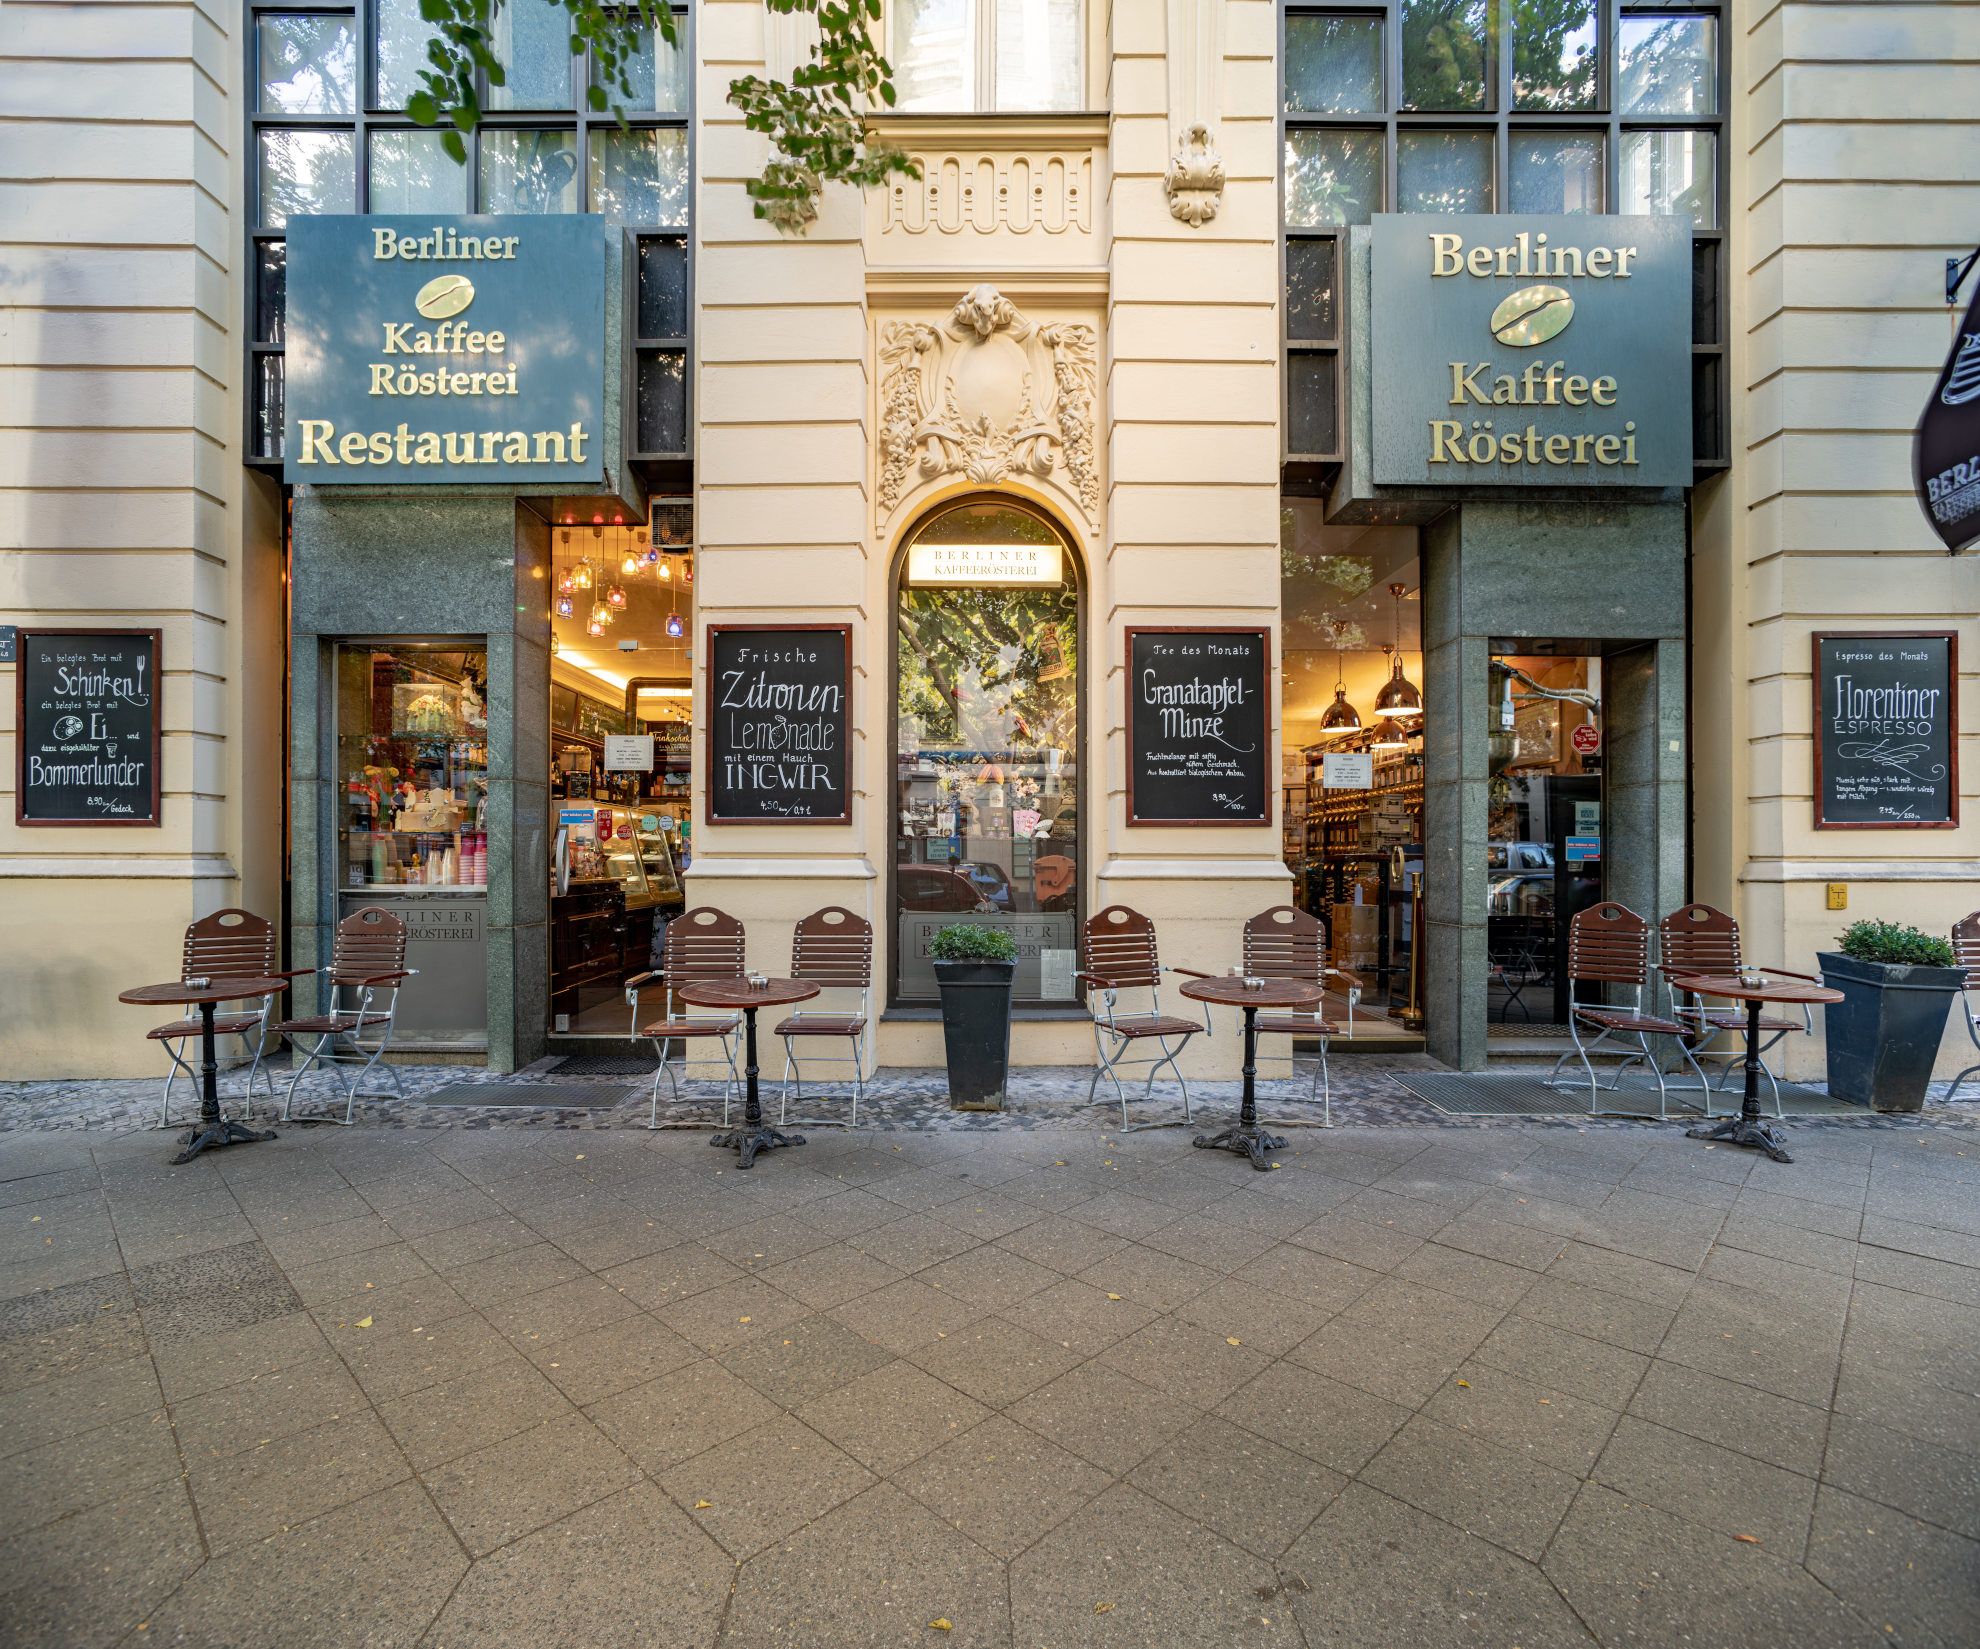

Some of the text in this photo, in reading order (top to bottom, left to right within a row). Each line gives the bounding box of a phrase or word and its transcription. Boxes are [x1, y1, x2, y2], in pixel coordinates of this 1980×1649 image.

[372, 227, 519, 259] Berliner
[1429, 232, 1637, 278] Berliner
[382, 321, 506, 353] Kaffee
[368, 363, 519, 396] Rösterei
[1449, 361, 1617, 406] Kaffee
[297, 419, 589, 465] Restaurant
[1429, 420, 1640, 464] Rösterei
[935, 551, 1037, 561] BERLINER
[935, 562, 1037, 576] KAFFEERÖSTEREI
[41, 653, 122, 667] Ein belegtes Brot mit
[738, 647, 817, 663] Frische
[1153, 644, 1250, 656] Tee des Monats
[1835, 651, 1929, 663] Espresso des Monats
[41, 701, 118, 711] ein belegtes Brot mit
[721, 670, 845, 713] Zitronen-
[1143, 668, 1254, 715] Granatapfel-
[1832, 674, 1941, 720] Florentiner
[731, 711, 835, 751] Lemonade
[1159, 707, 1224, 739] Minze
[1834, 720, 1932, 736] ESPRESSO
[29, 755, 144, 787] Bommerlunder
[724, 752, 813, 763] mit einem Hauch
[1188, 752, 1200, 760] mit
[726, 763, 837, 790] INGWER
[110, 804, 135, 813] Gedeck
